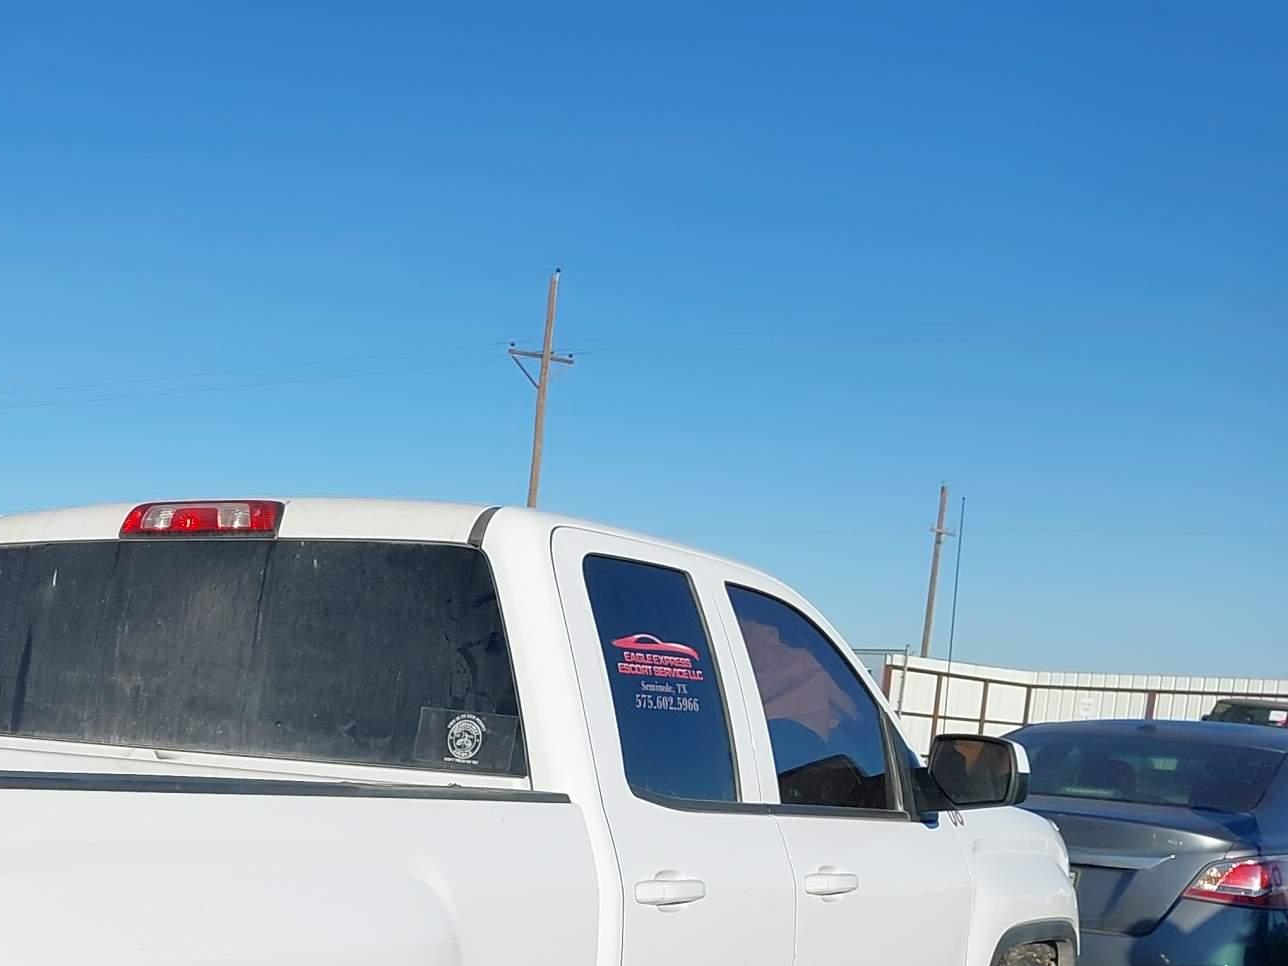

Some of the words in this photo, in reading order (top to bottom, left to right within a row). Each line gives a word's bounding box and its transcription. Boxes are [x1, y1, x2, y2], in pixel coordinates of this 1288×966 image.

[623, 651, 653, 664] EAGLE
[653, 655, 692, 668] EXPRESS
[618, 662, 652, 676] ESCORT
[653, 666, 689, 679] SERVICE
[688, 669, 704, 681] LLC
[676, 683, 689, 694] TX
[635, 693, 700, 713] 575.602.5966
